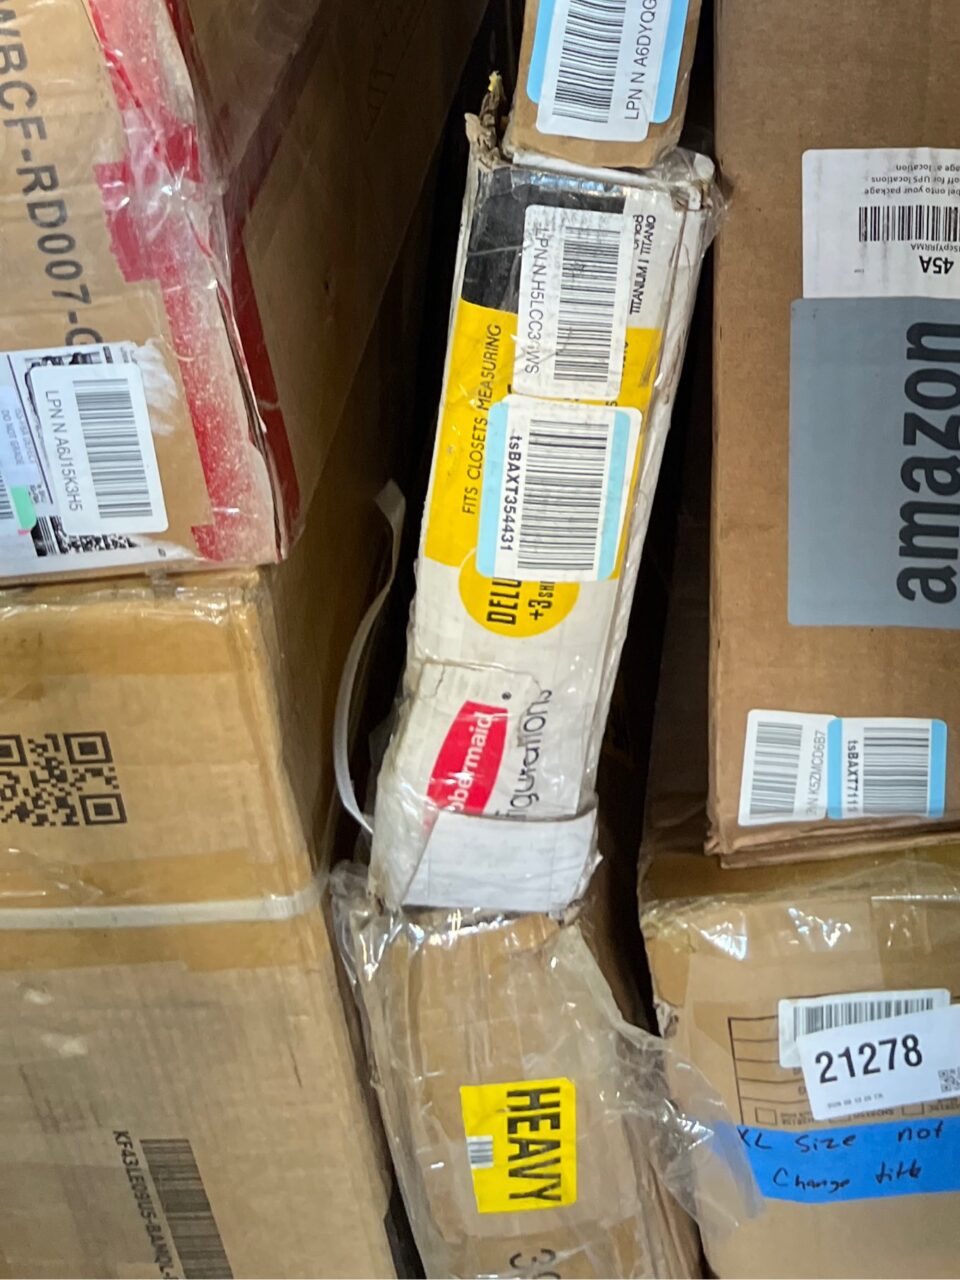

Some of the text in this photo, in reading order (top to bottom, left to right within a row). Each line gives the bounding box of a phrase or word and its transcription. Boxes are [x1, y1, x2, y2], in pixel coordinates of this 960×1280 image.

[630, 72, 645, 84] N
[624, 88, 642, 120] LPN
[896, 163, 931, 173] location
[864, 186, 902, 196] package
[871, 176, 911, 185] locations
[904, 185, 924, 195] your
[925, 187, 946, 195] onto
[933, 176, 945, 185] for
[533, 225, 549, 259] LPN
[919, 255, 954, 274] 45A
[462, 323, 502, 515] FITS CLOSETS MEASURING
[45, 390, 83, 512] LPN N A6J15K3H5
[499, 434, 522, 553] tsBAXT354431
[814, 1033, 923, 1084] 21278
[506, 1086, 562, 1202] HEAVY
[737, 1127, 773, 1150] XL
[898, 1120, 944, 1142] not
